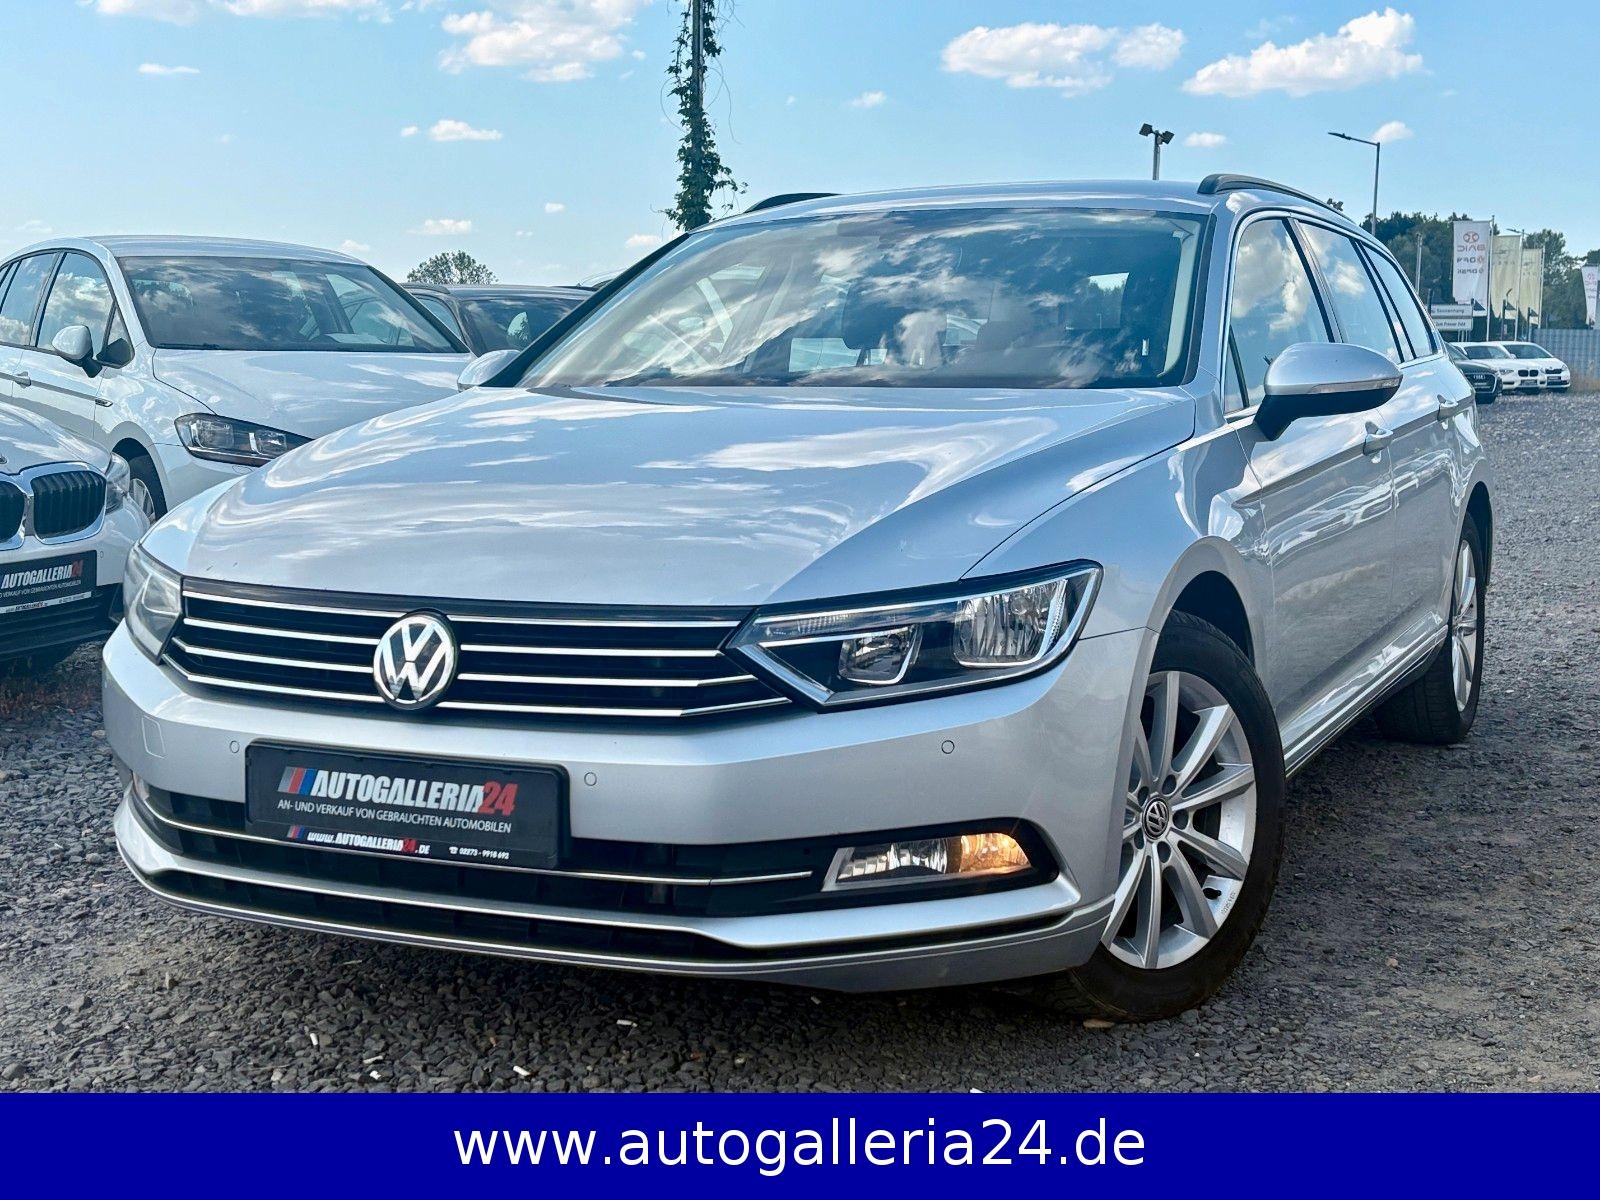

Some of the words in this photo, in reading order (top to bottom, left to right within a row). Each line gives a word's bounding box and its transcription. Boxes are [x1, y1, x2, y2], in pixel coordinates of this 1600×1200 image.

[1, 560, 84, 590] AUTOGALLERIA24
[310, 769, 518, 816] AUTOGALLERIA24
[278, 799, 293, 810] AN-
[294, 801, 315, 813] UND
[315, 804, 355, 817] VERKAUF
[355, 807, 376, 820] VON
[376, 810, 442, 827] GEBRAUCHTEN
[442, 816, 512, 834] AUTOMOBILEN
